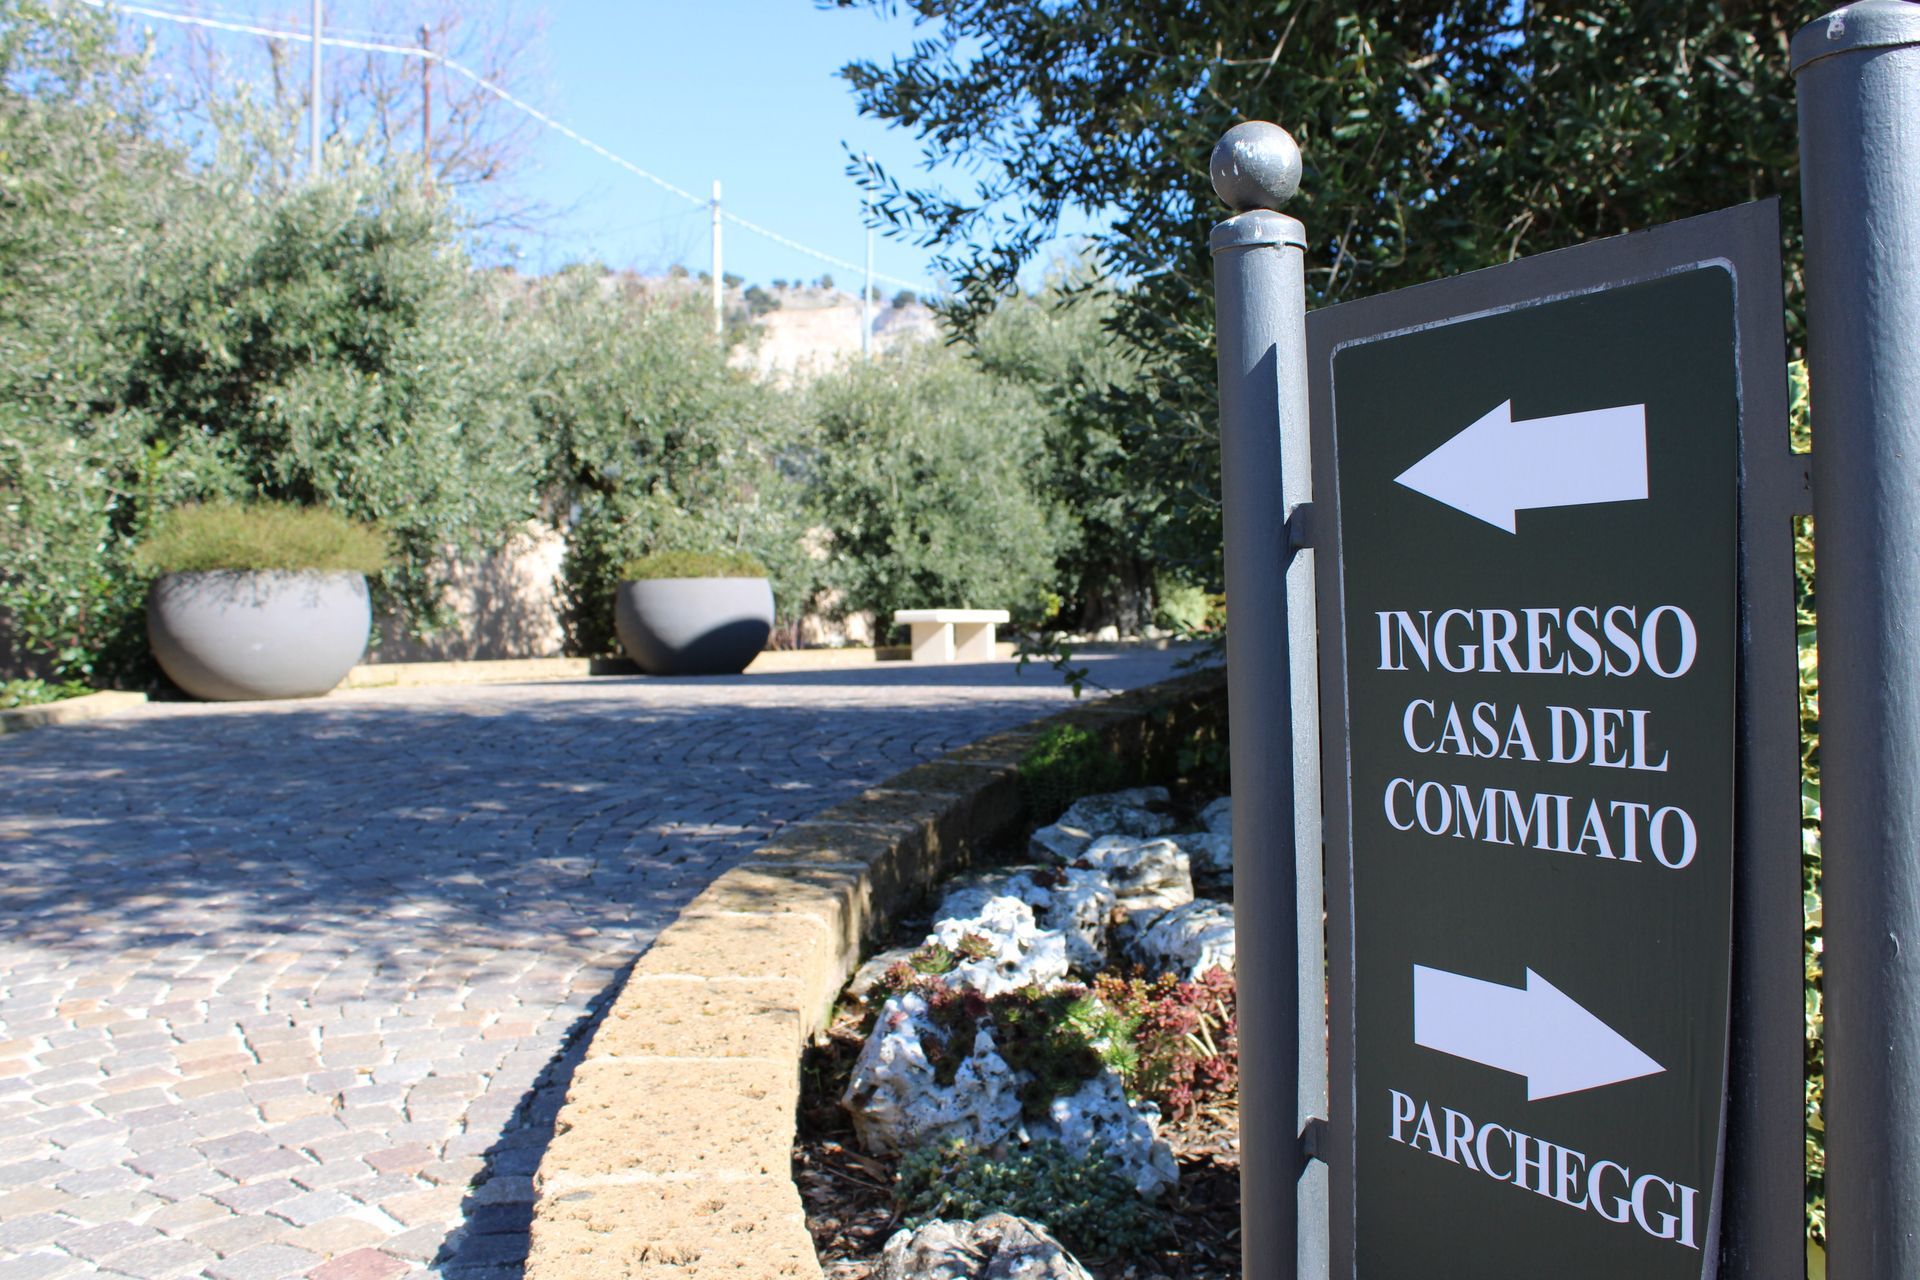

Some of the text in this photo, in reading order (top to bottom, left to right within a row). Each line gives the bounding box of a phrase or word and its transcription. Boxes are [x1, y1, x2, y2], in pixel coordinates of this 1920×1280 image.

[1375, 605, 1698, 679] INGRESSO
[1402, 699, 1669, 772] CASA DEL
[1384, 777, 1697, 870] COMMIATO
[1388, 1088, 1700, 1250] PARCHEGGI
